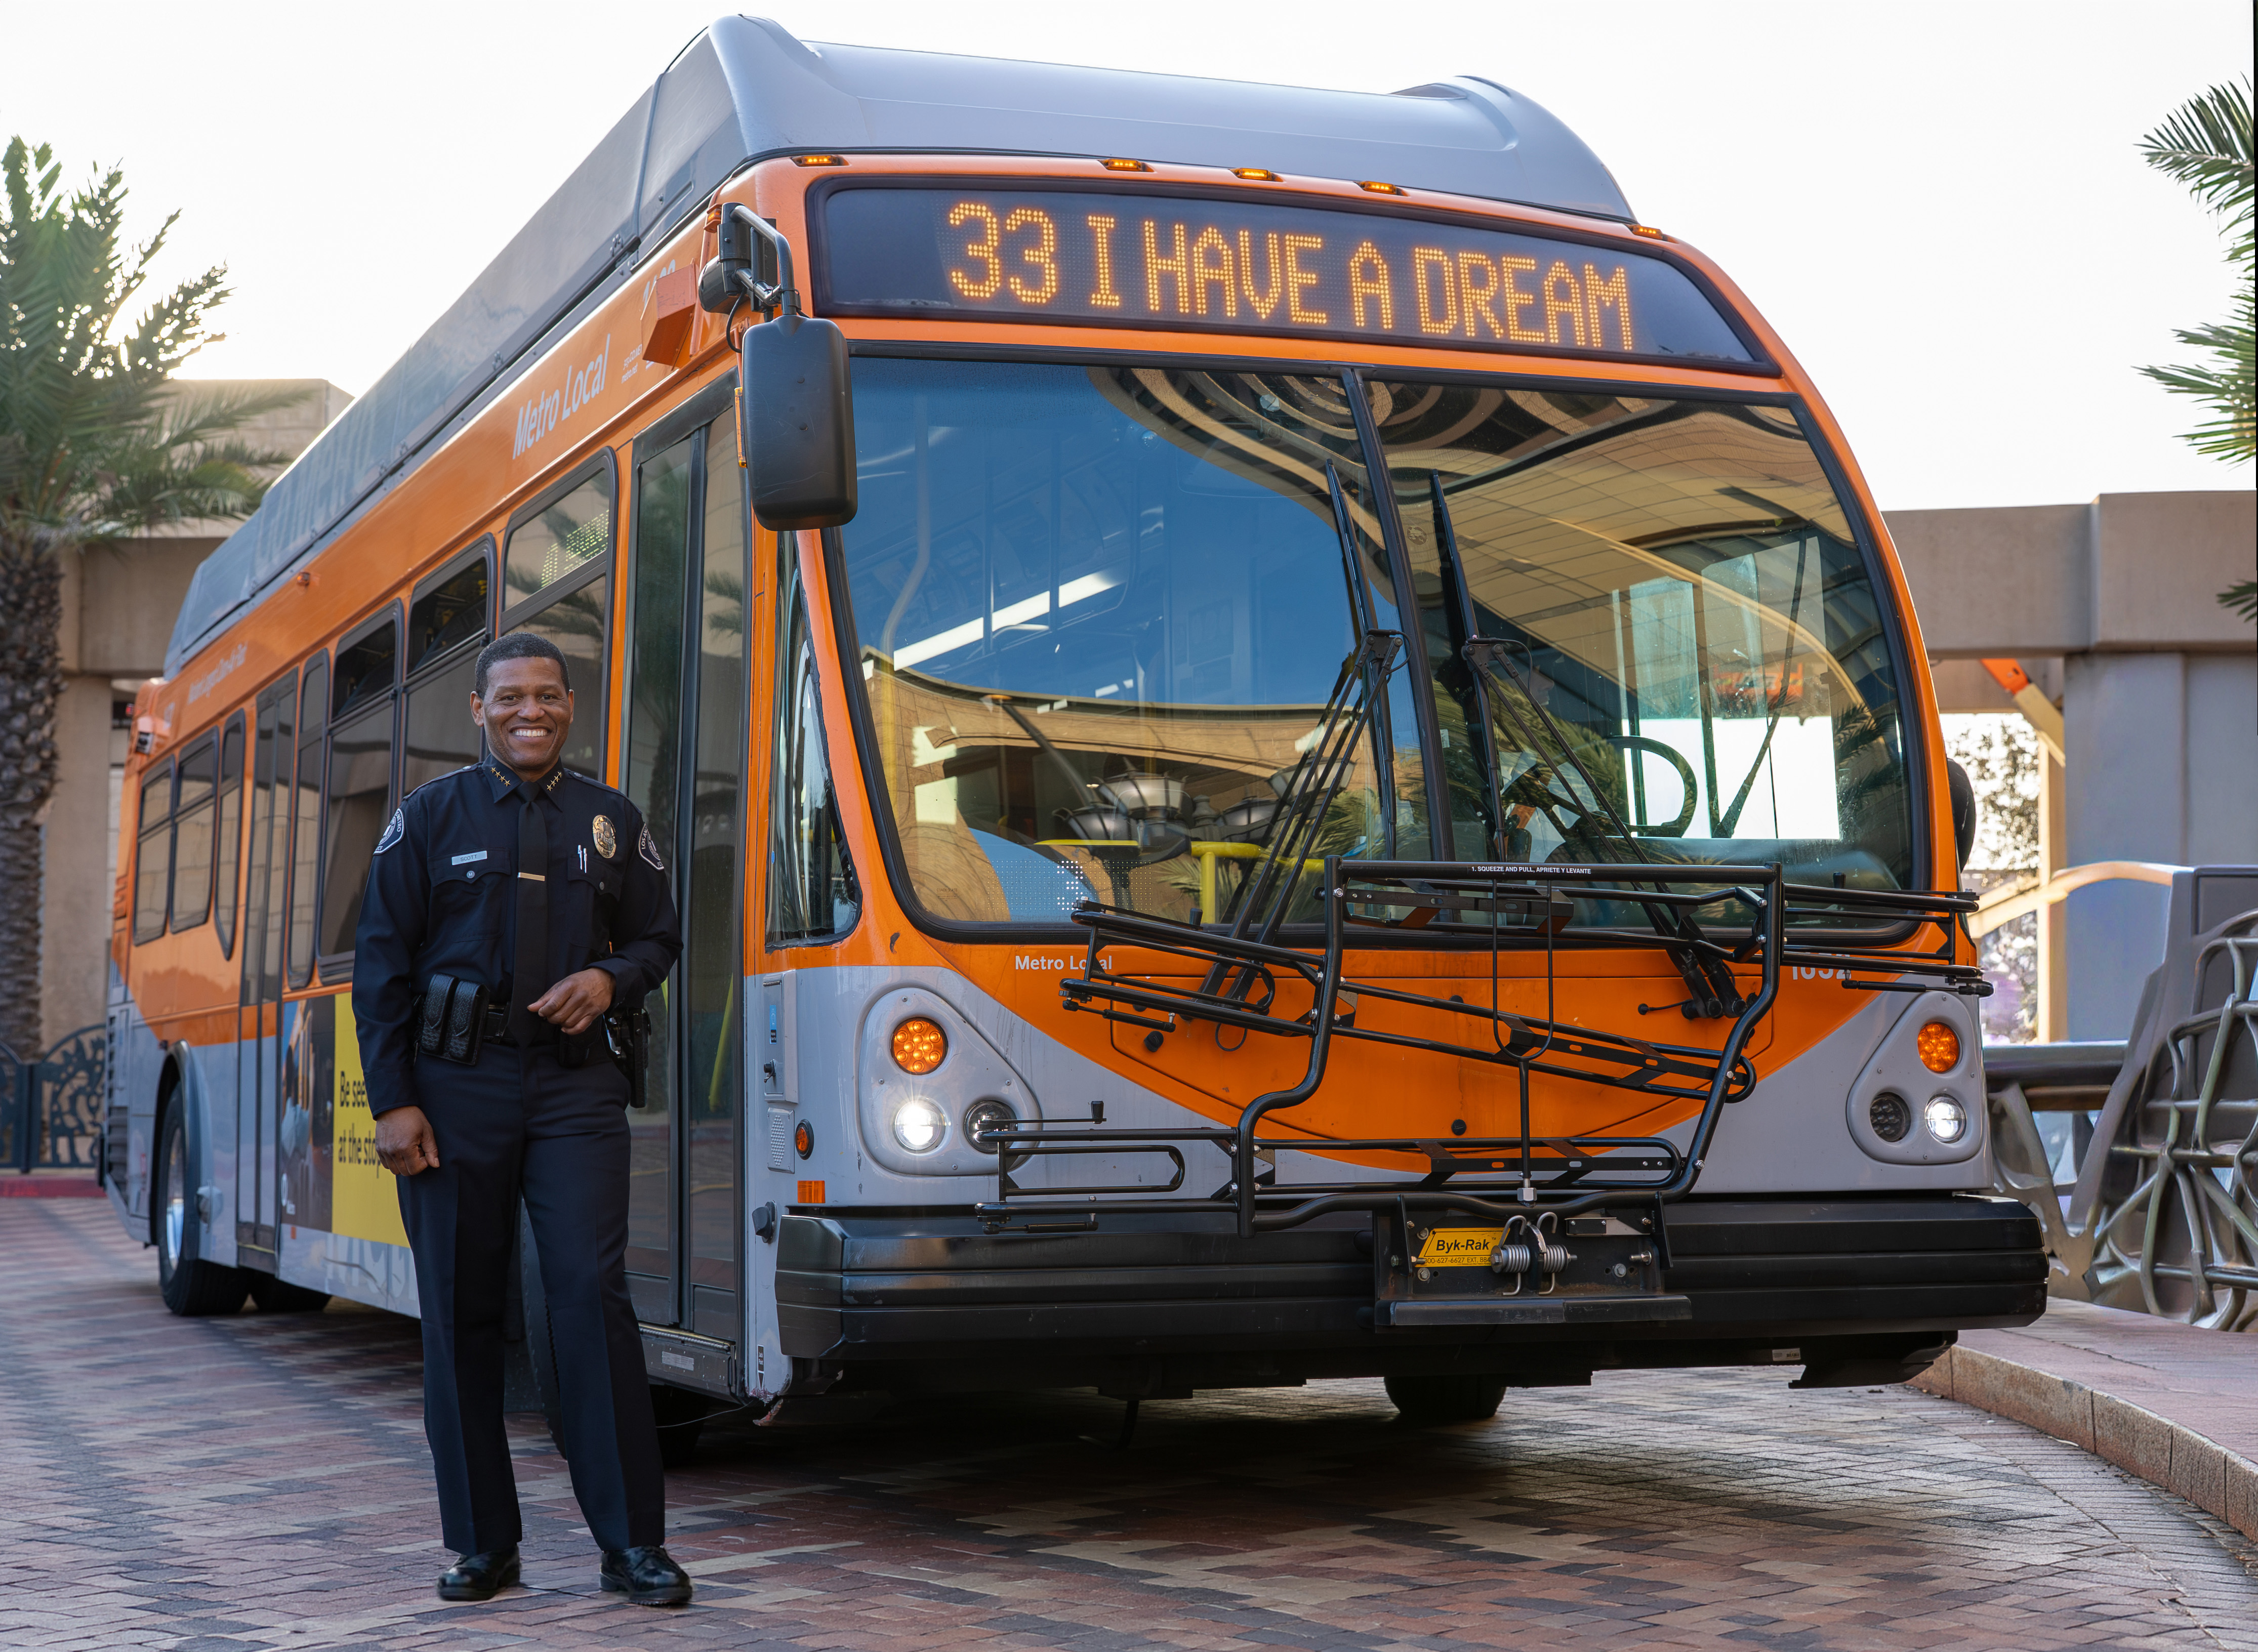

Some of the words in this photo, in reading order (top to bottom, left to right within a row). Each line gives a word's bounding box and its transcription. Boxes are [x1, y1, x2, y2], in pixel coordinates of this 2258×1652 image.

[950, 203, 1056, 304] 33
[1088, 215, 1119, 306] I
[1144, 221, 1327, 325] HAVE
[1350, 241, 1392, 329] A
[1415, 246, 1632, 350] DREAM
[513, 389, 560, 460] Metro
[561, 334, 610, 421] Local
[1015, 955, 1064, 970] Metro
[1070, 955, 1112, 970] Loal
[340, 1070, 349, 1107] Be
[352, 1080, 368, 1107] see
[339, 1129, 346, 1163] at
[348, 1122, 361, 1164] the
[1436, 1239, 1490, 1254] Byk-Rak
